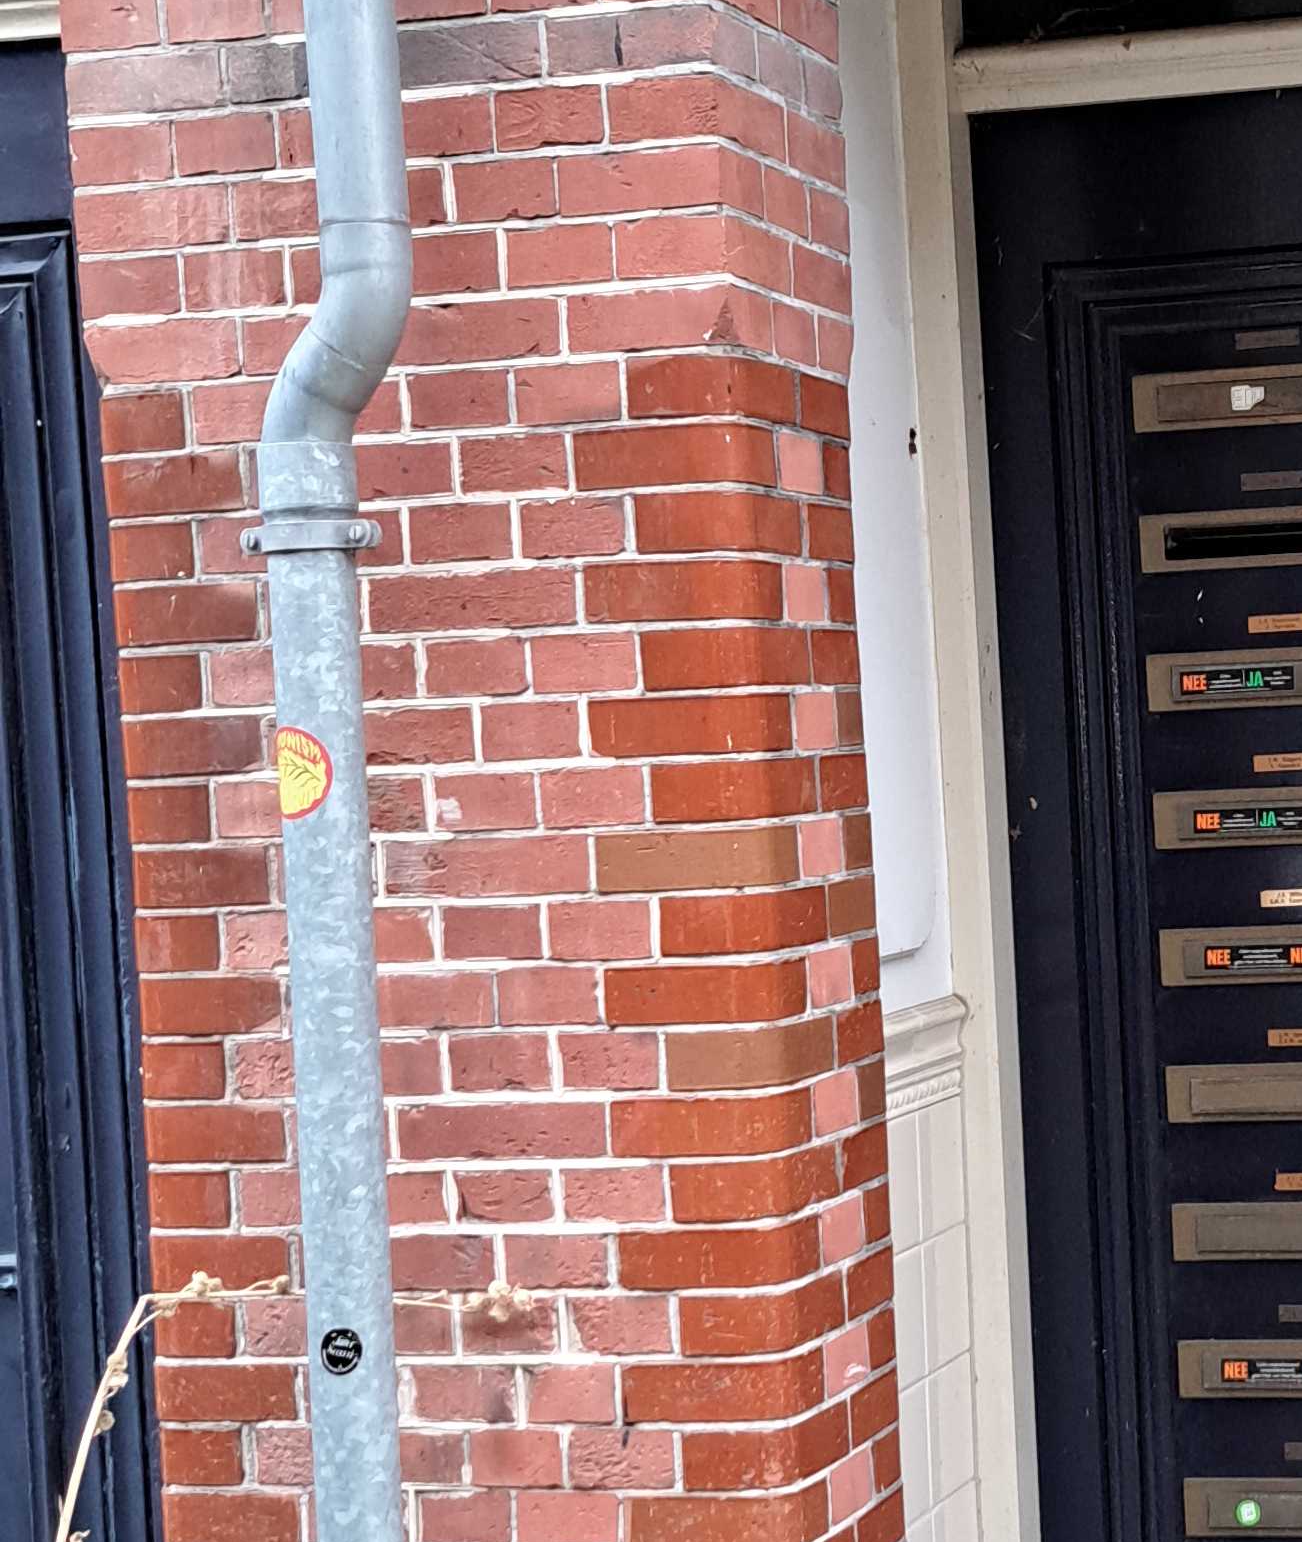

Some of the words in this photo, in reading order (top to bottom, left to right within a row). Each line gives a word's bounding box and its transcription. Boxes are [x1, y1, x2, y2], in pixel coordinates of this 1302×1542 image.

[1183, 673, 1207, 691] NEE
[1246, 670, 1264, 688] JA
[1196, 813, 1220, 830] NEE
[1259, 811, 1277, 827] JA
[1206, 948, 1231, 966] NEE
[1224, 1361, 1248, 1379] NEE
